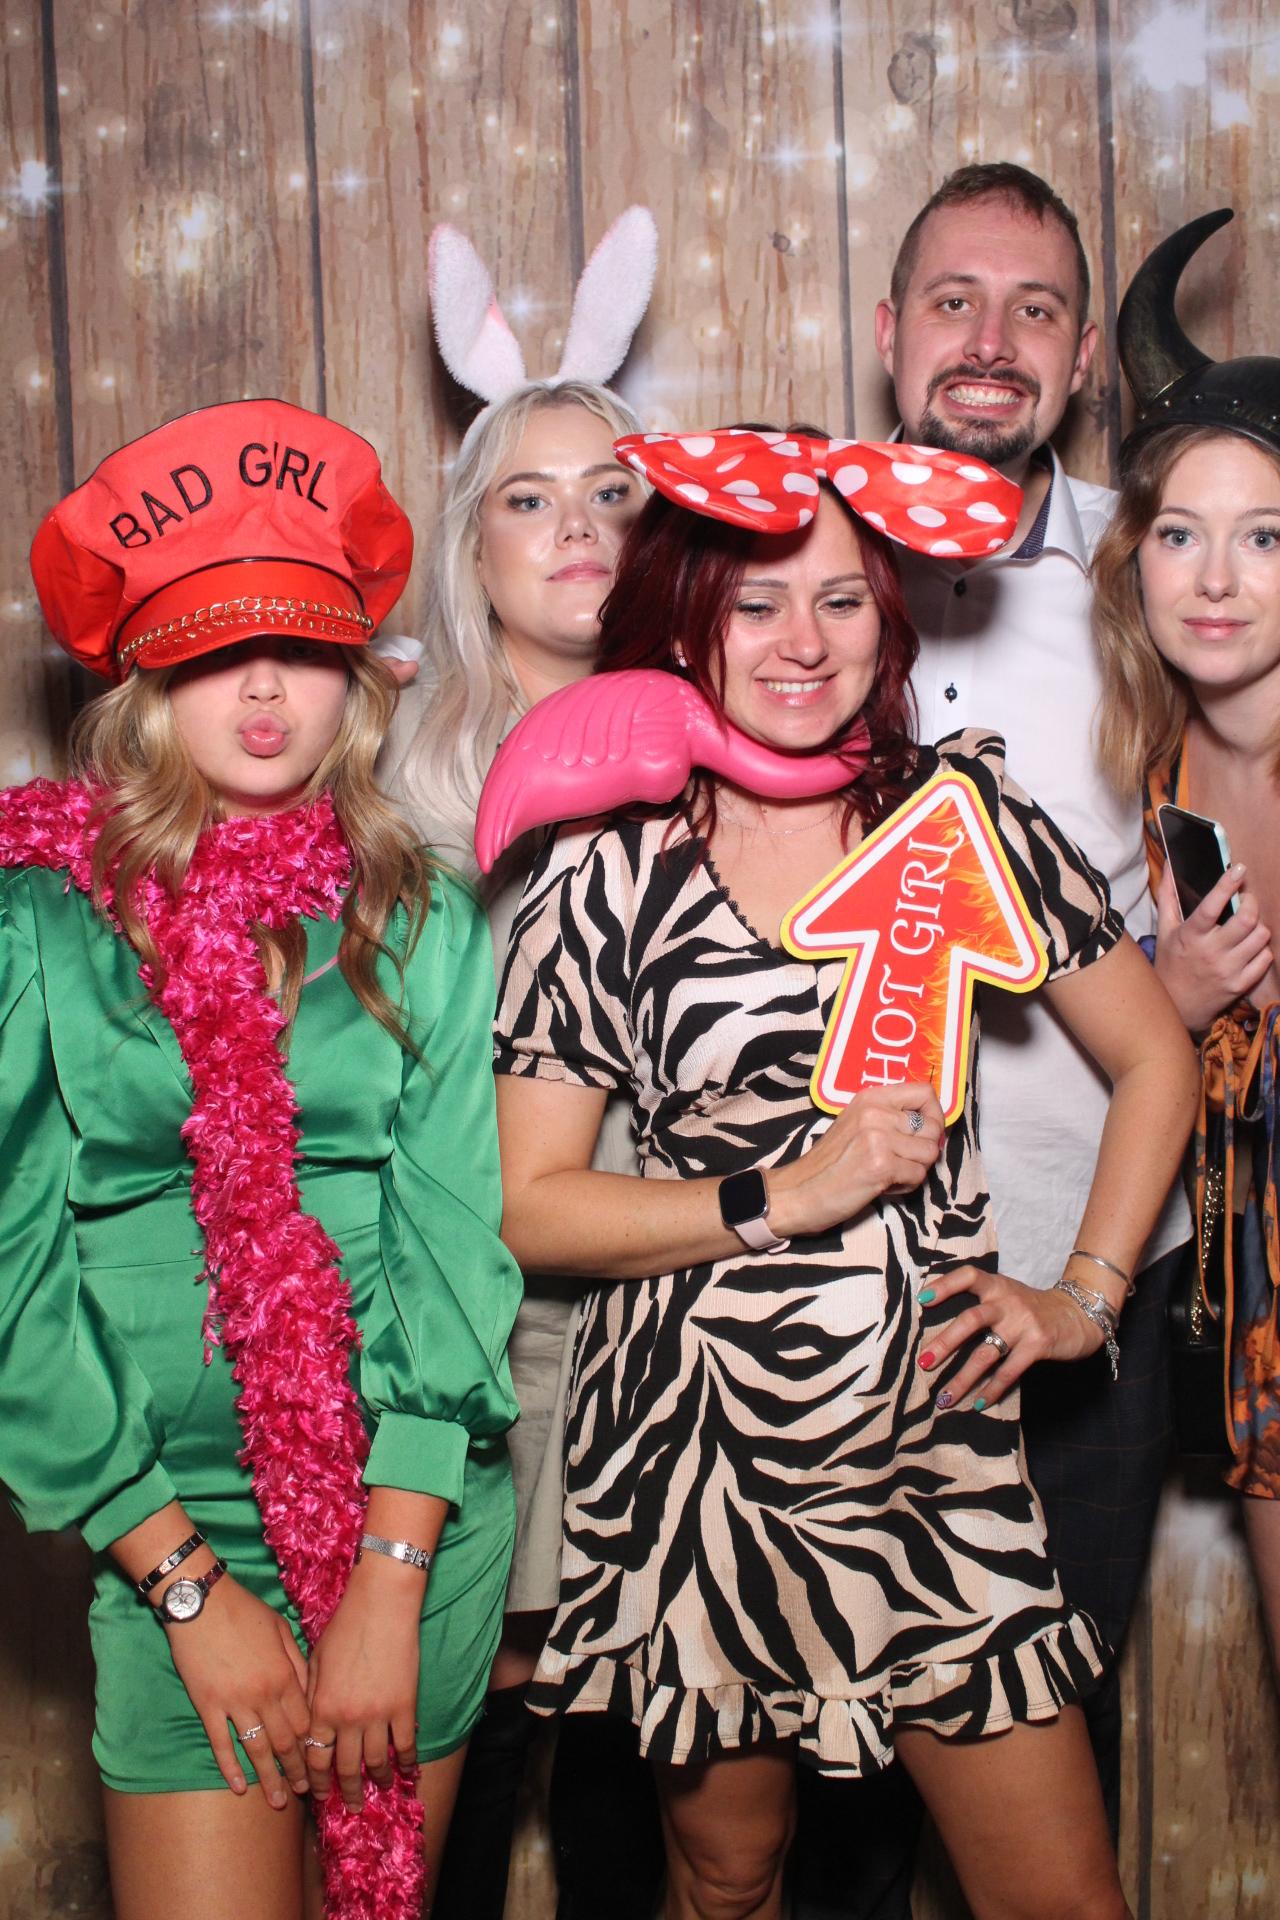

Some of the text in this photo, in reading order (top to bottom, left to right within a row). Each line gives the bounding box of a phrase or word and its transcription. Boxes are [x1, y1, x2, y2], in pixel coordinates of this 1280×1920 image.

[109, 464, 213, 549] BAD
[860, 829, 966, 1087] HOT GIRL
